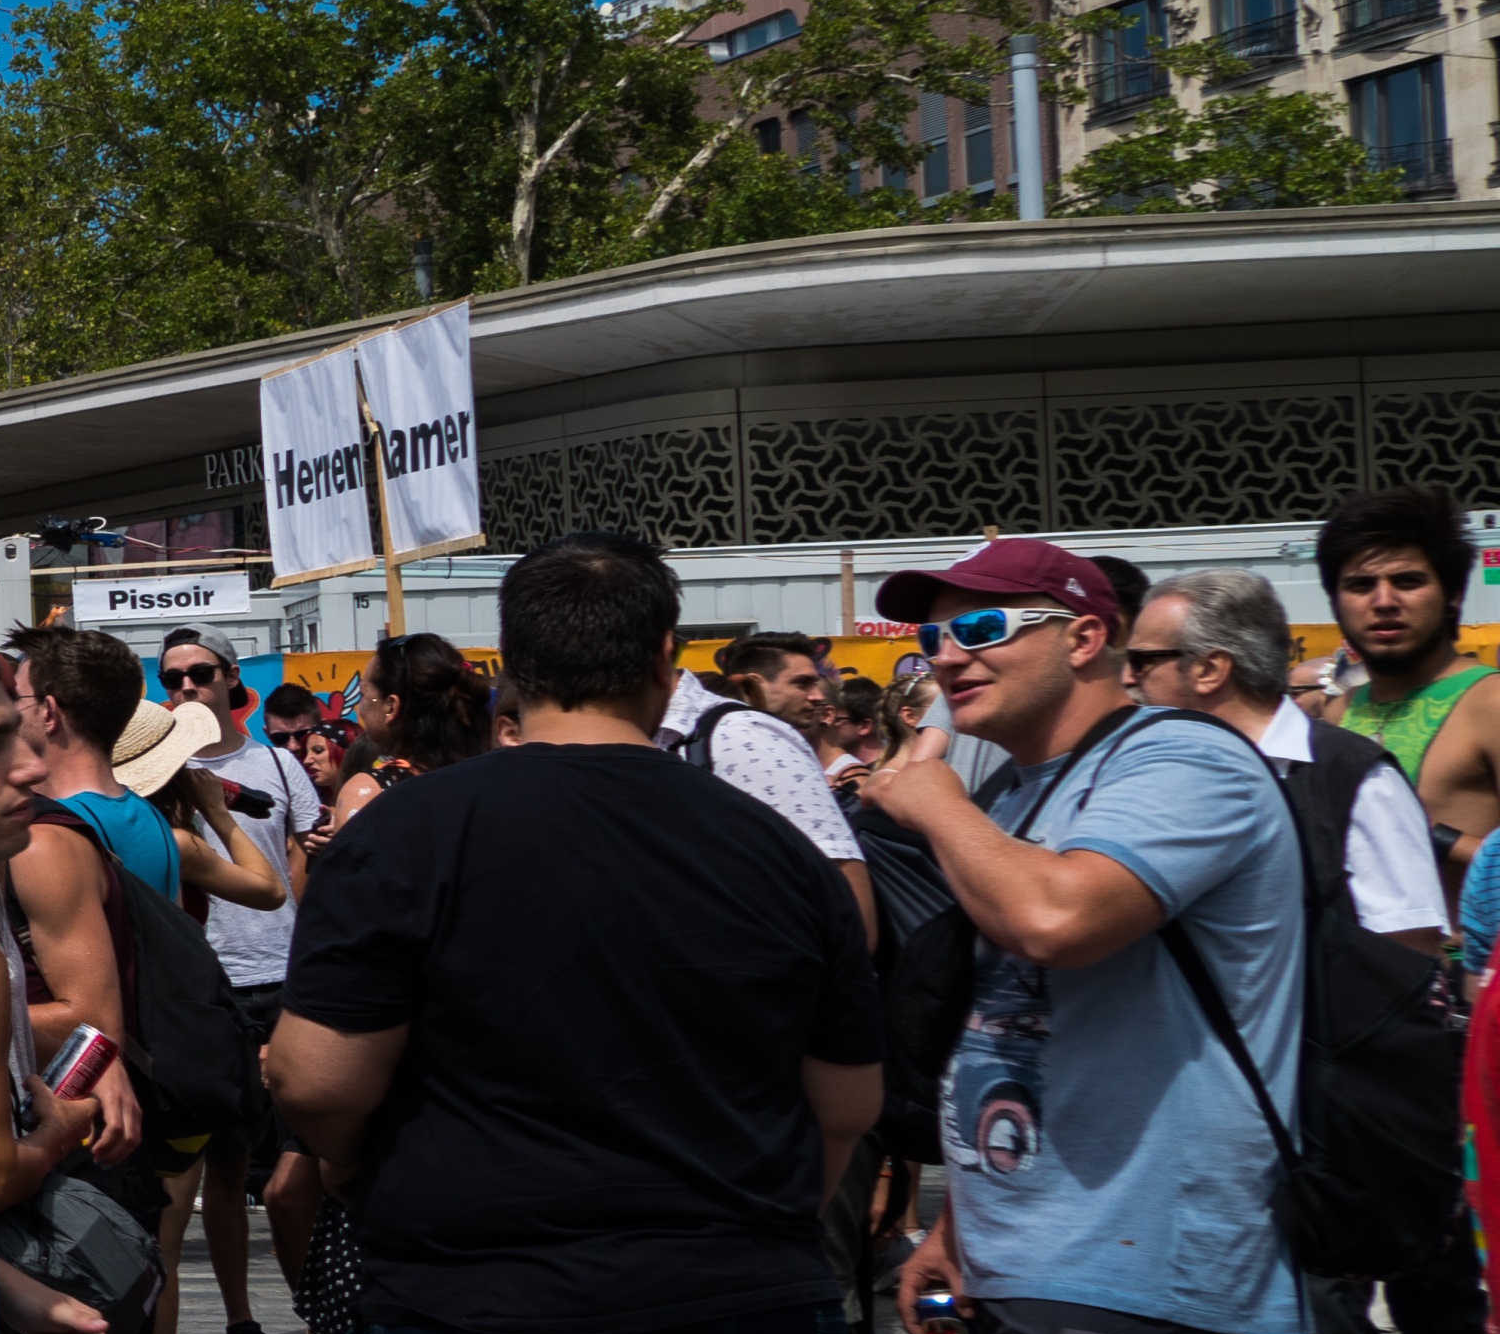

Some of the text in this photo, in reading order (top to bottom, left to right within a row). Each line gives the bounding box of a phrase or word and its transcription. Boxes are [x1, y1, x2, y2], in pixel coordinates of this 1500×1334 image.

[273, 442, 364, 509] Herren
[108, 585, 214, 611] Pissoir
[354, 594, 370, 609] 15
